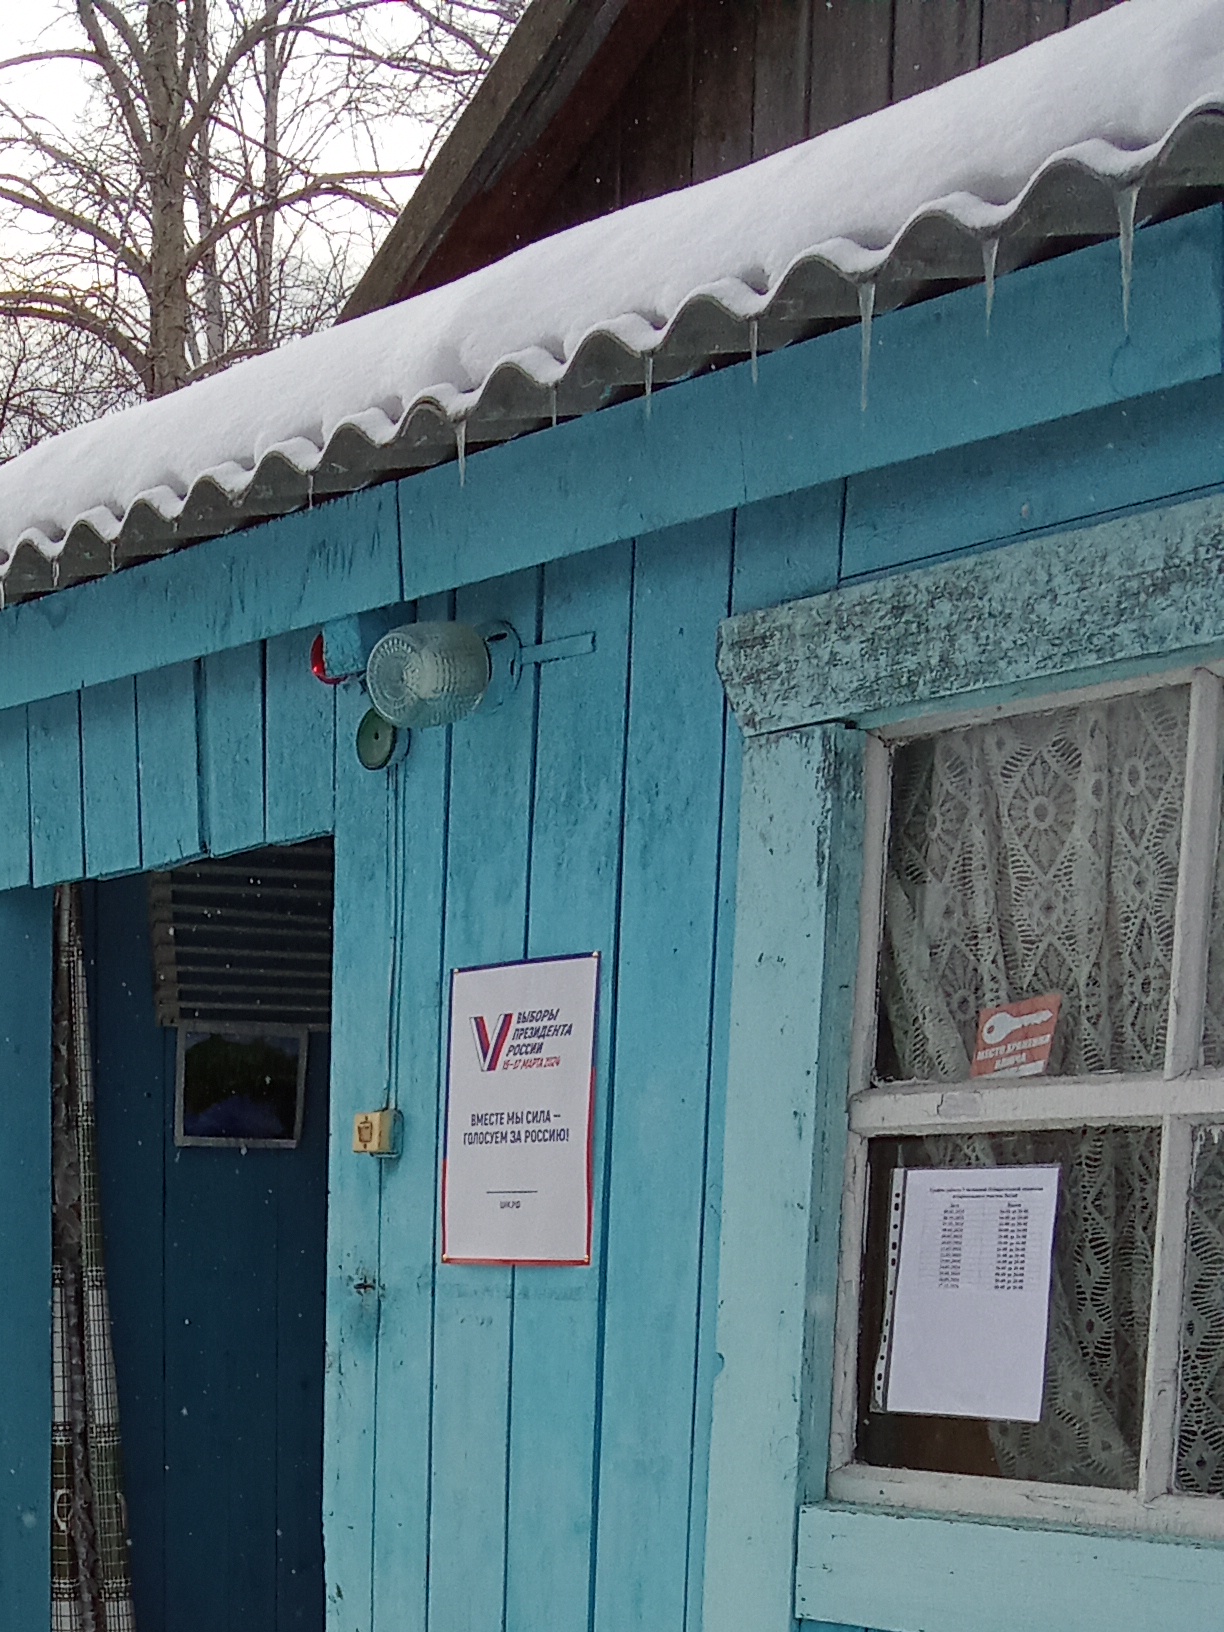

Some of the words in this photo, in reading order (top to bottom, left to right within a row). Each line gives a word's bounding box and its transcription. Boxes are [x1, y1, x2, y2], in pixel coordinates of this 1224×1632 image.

[516, 1008, 560, 1024] ВЫБОРЫ
[512, 1023, 573, 1041] ПРЕЗИДЕНТА
[506, 1042, 544, 1057] РОССИИ
[471, 1112, 505, 1127] ВМЕСТЕ
[506, 1111, 524, 1125] МЫ
[526, 1110, 551, 1124] СИЛА
[463, 1130, 508, 1145] ГОЛОСУЕМ
[509, 1130, 522, 1144] ЗА
[524, 1128, 570, 1144] РОССИЮ!
